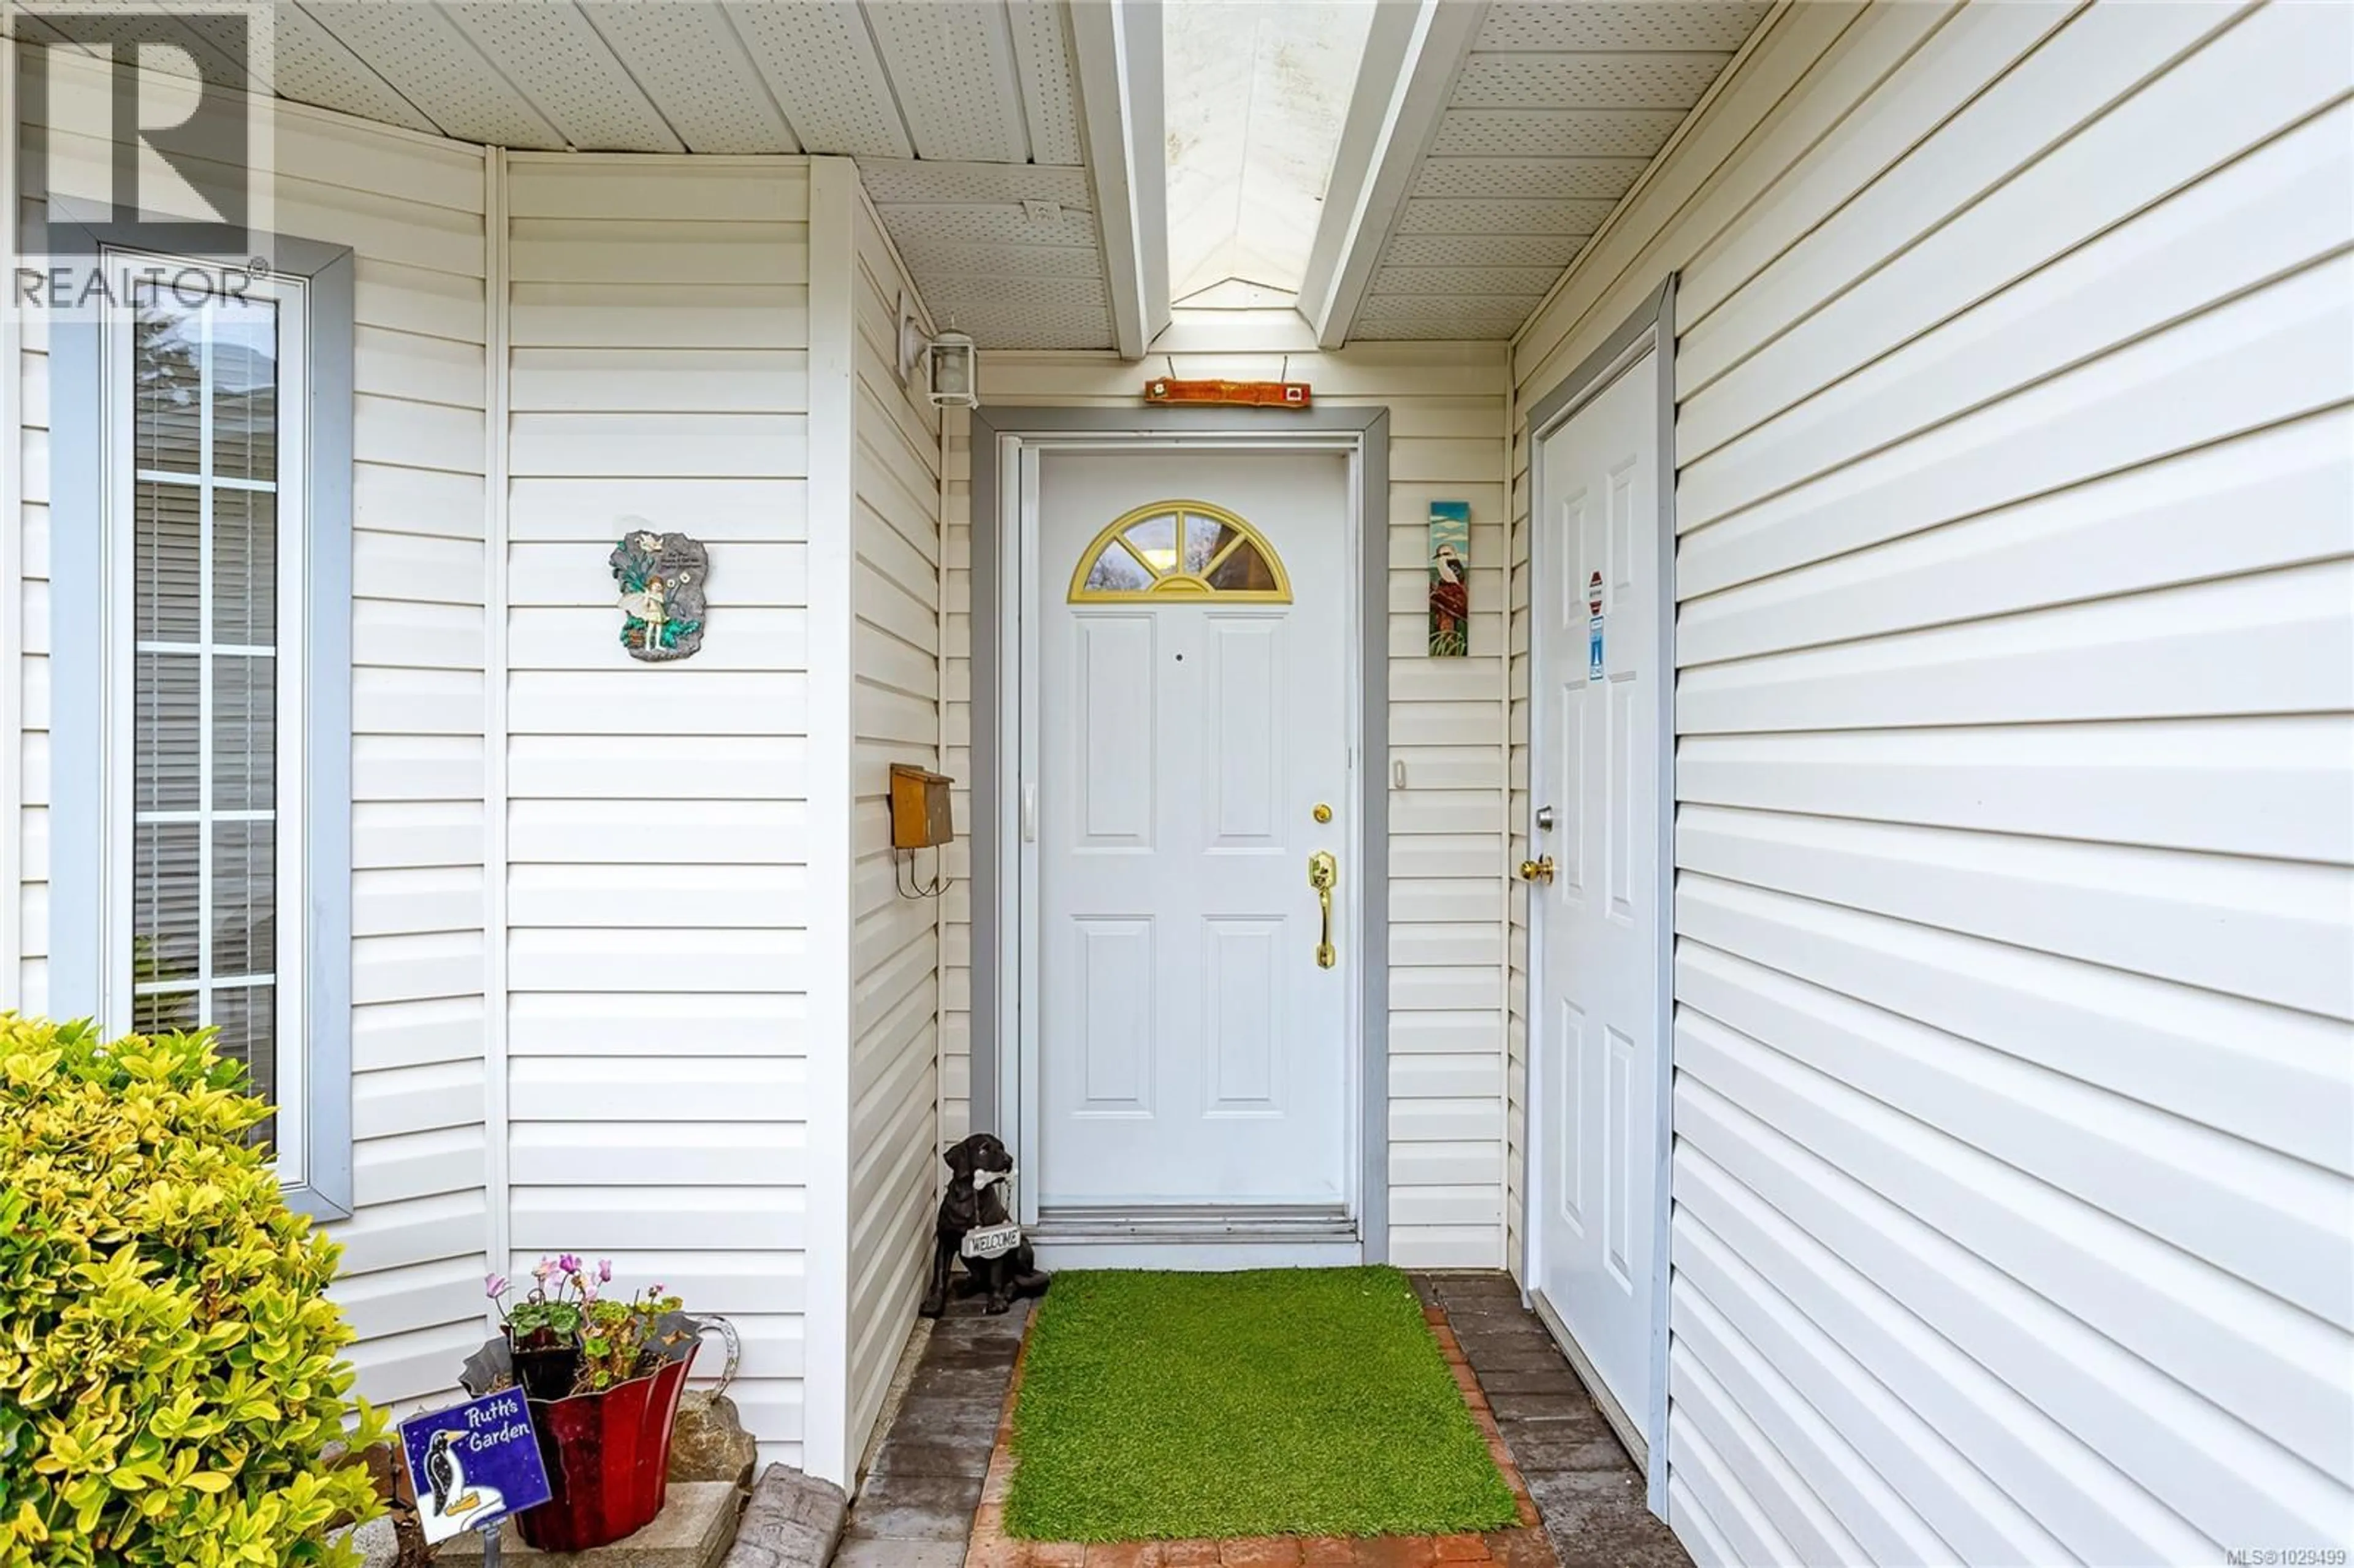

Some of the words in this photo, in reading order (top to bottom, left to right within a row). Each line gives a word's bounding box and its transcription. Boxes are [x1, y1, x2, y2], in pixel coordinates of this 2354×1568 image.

[972, 1230, 1018, 1252] WELCOME
[465, 1398, 519, 1428] Ruth's
[469, 1421, 530, 1452] Garden
